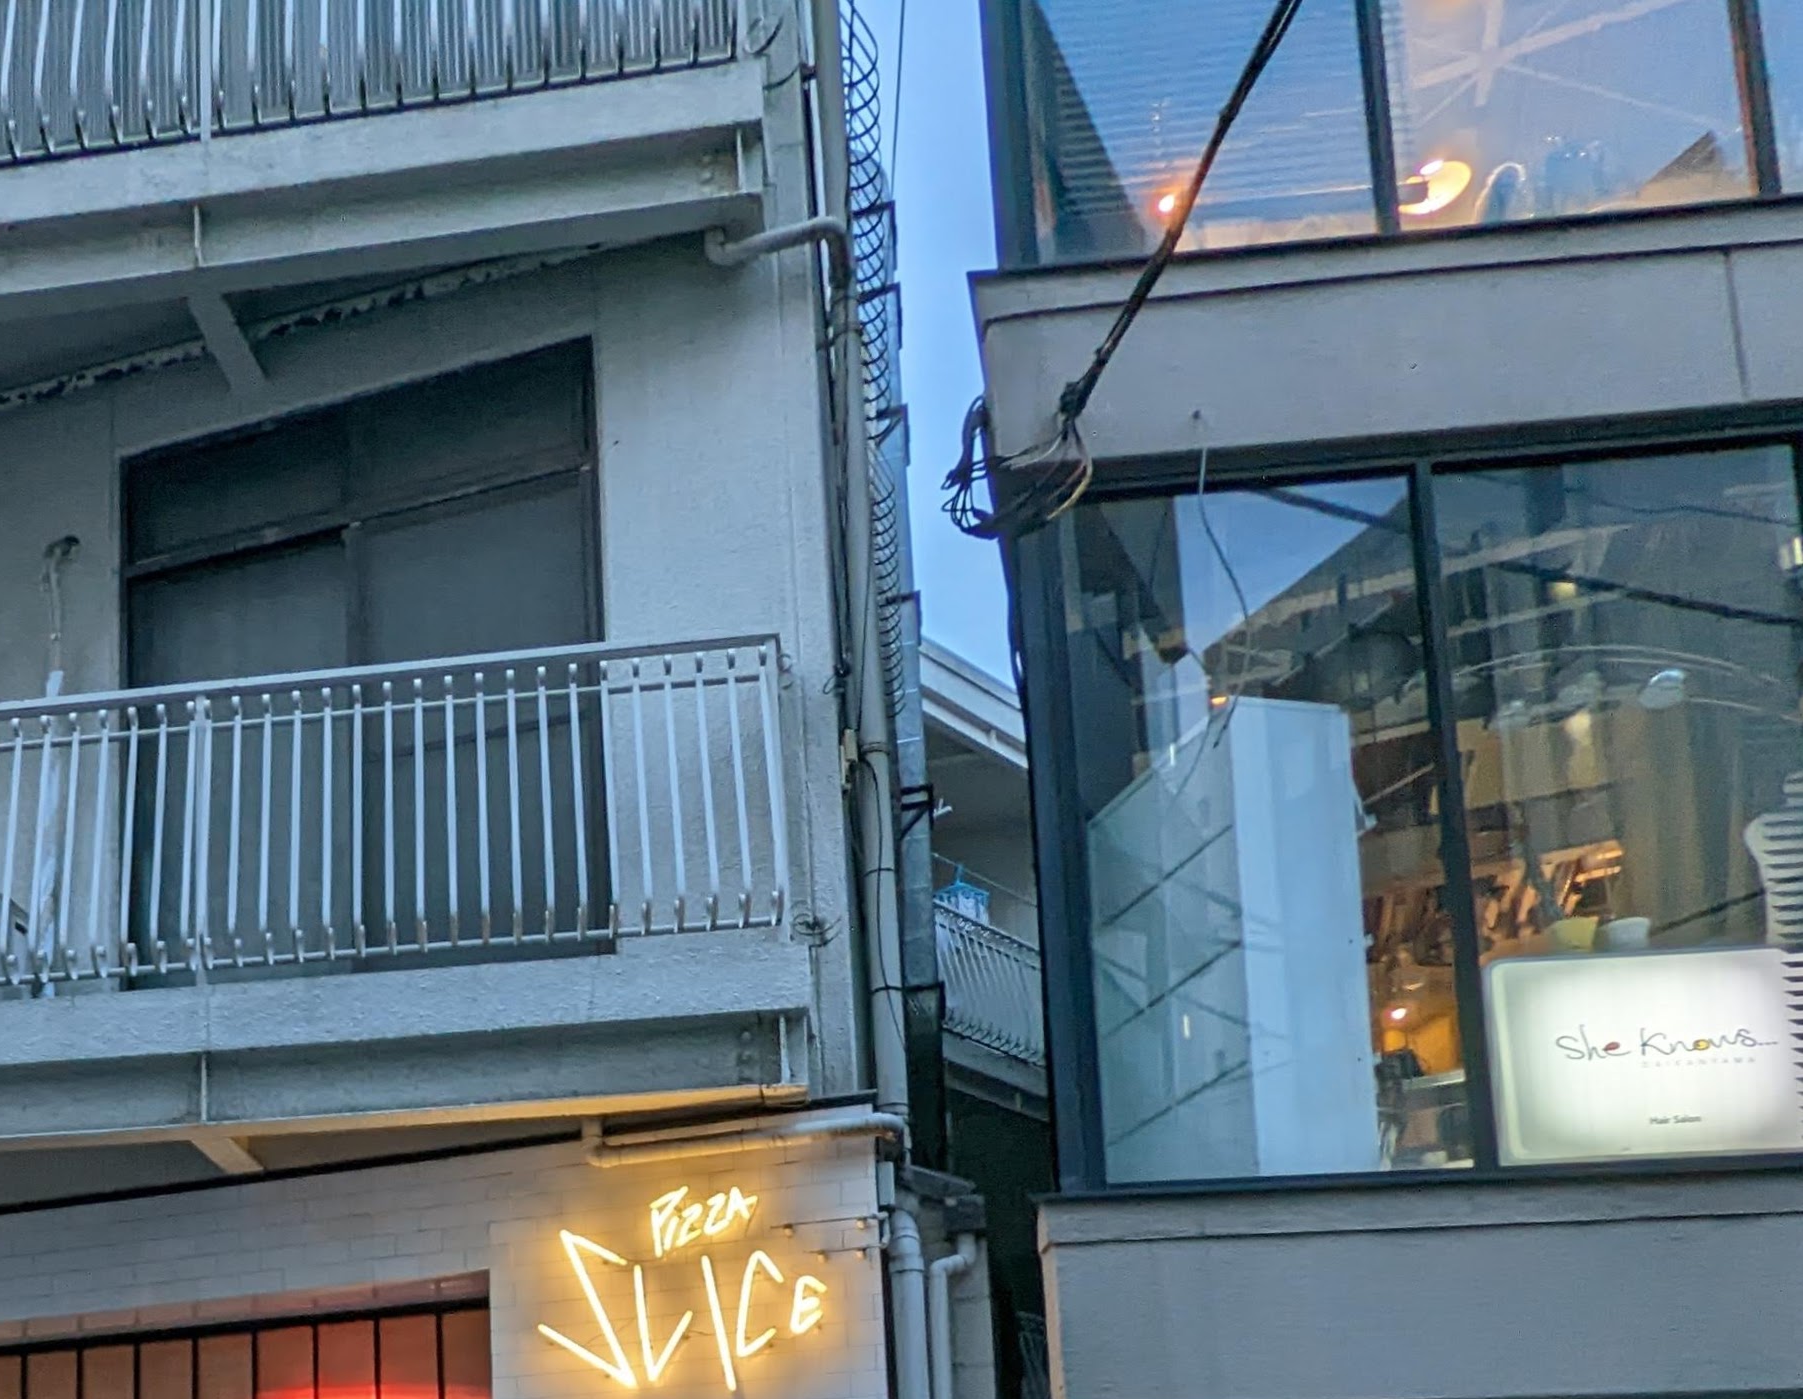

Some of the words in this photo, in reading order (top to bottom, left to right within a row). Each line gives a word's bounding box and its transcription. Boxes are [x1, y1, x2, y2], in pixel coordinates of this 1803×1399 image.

[1556, 1024, 1630, 1060] She
[1649, 1116, 1670, 1125] Hair
[1673, 1114, 1702, 1124] Salon
[538, 1229, 827, 1392] SLICE
